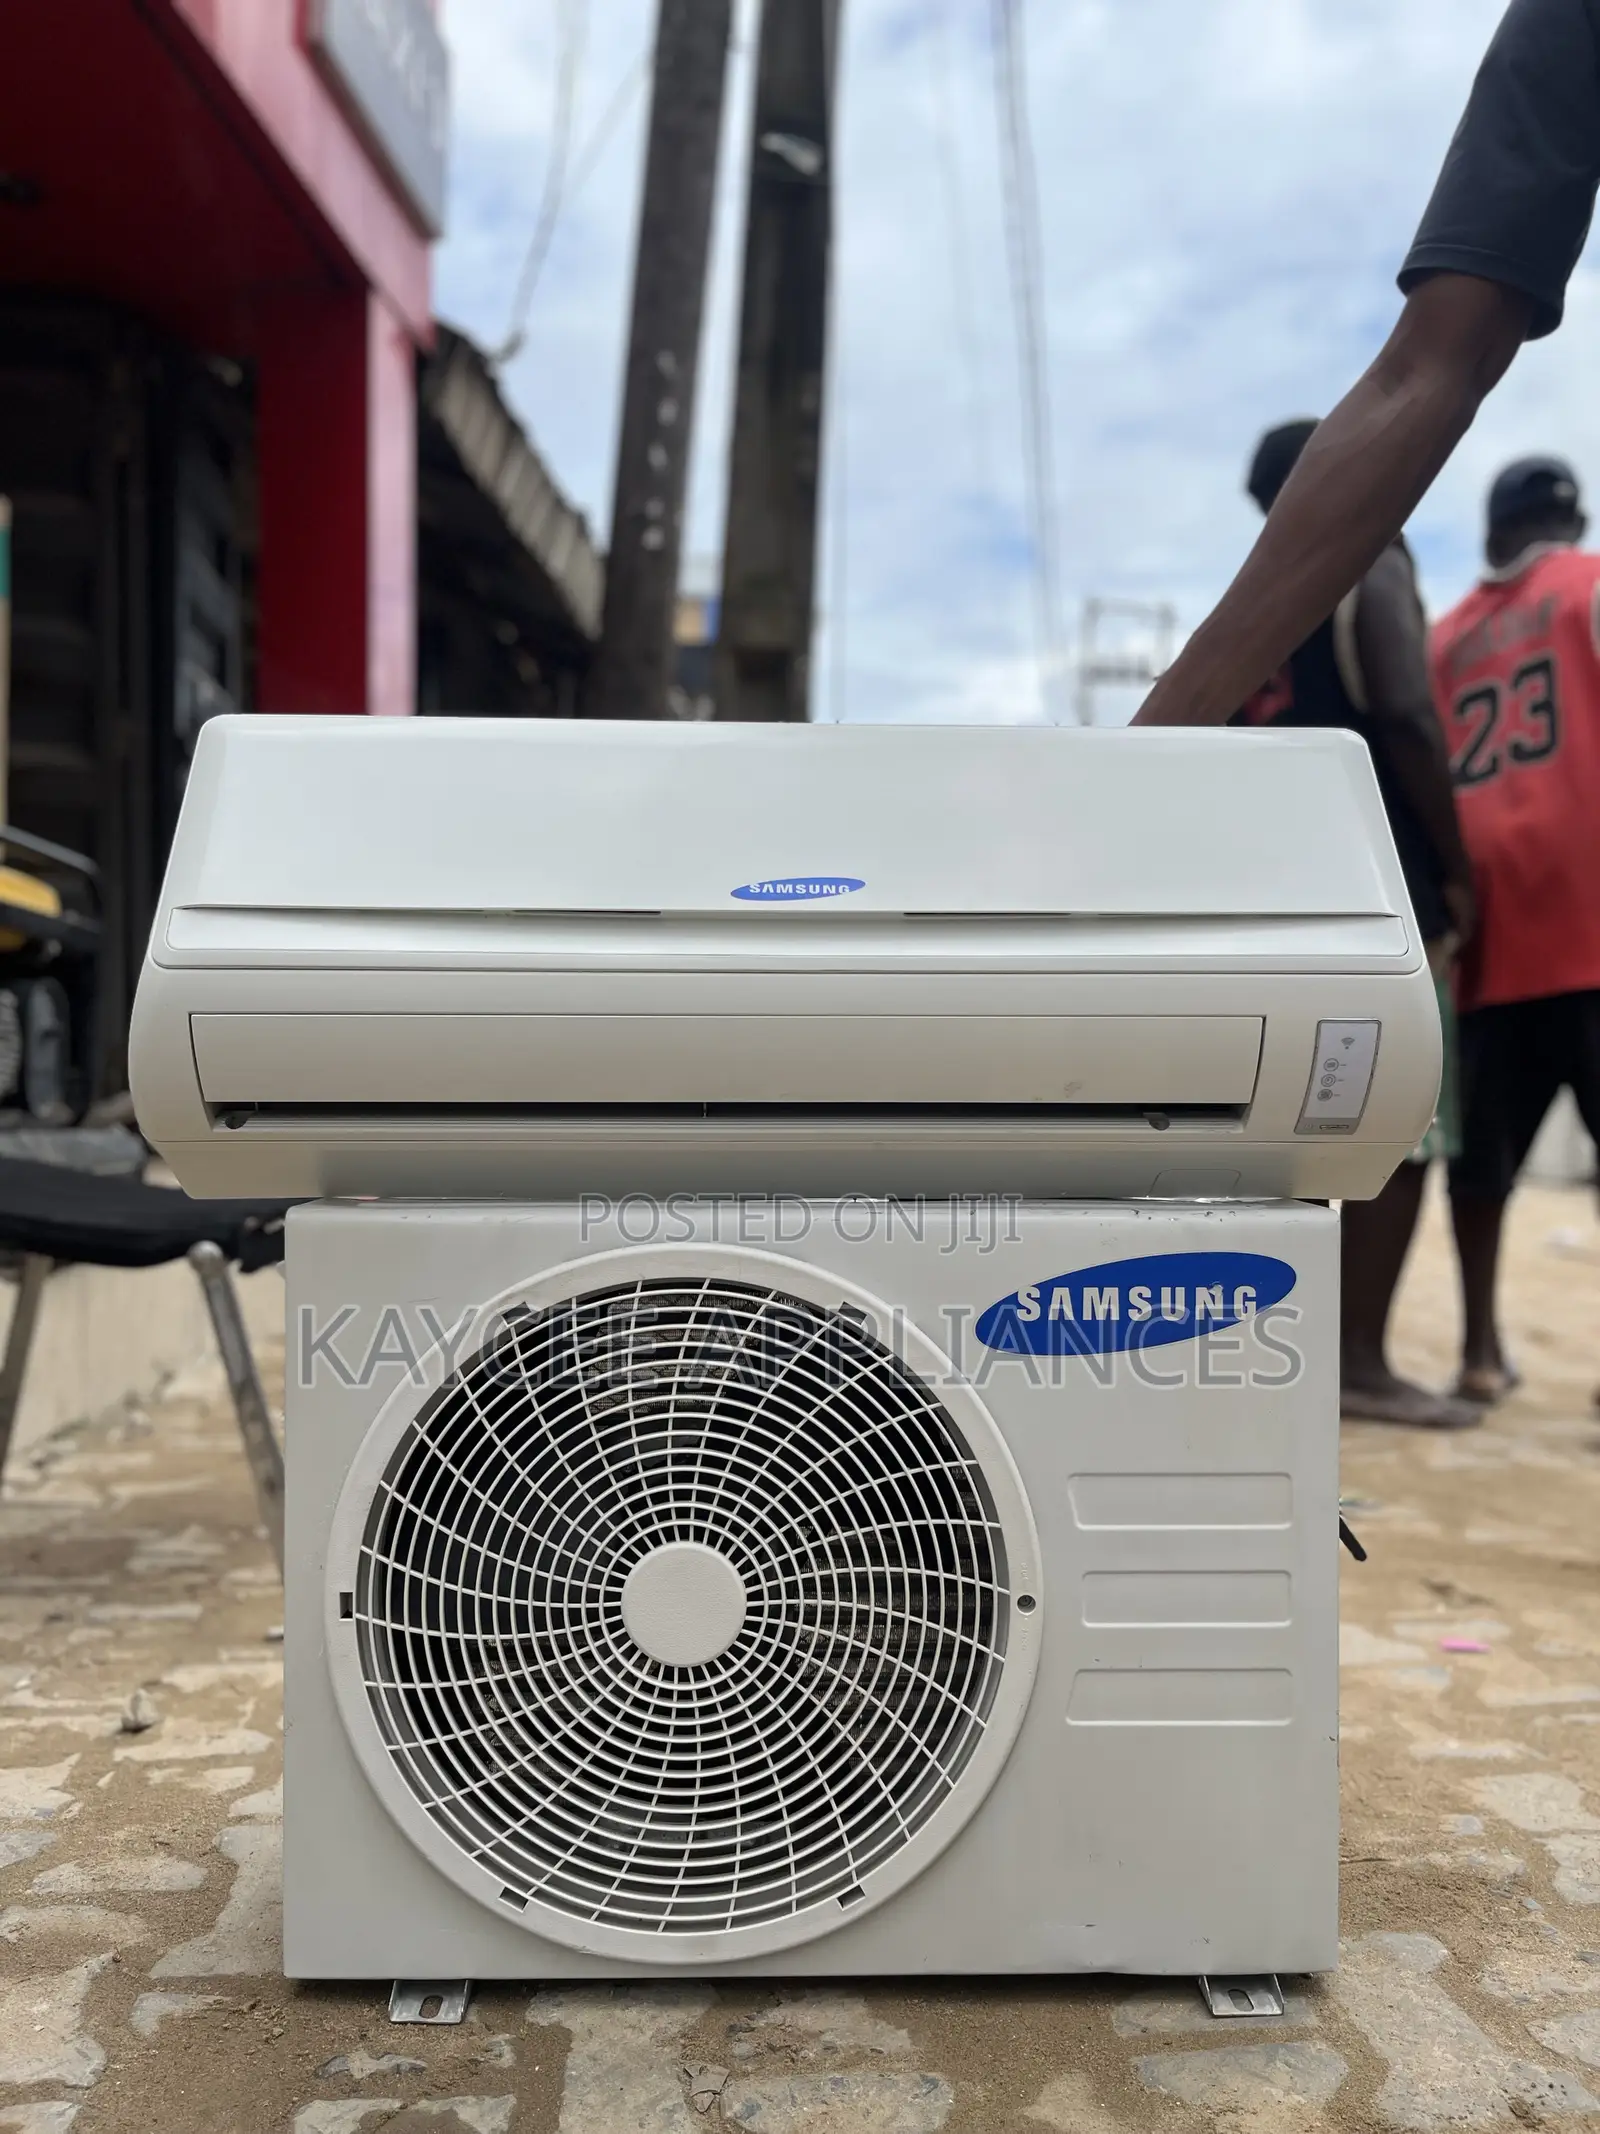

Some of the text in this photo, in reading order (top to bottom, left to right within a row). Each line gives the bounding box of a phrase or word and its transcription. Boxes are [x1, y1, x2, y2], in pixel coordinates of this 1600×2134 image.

[1450, 655, 1558, 787] 23
[749, 883, 851, 895] SAMSUNG
[1017, 1285, 1258, 1322] SAMSUNG
